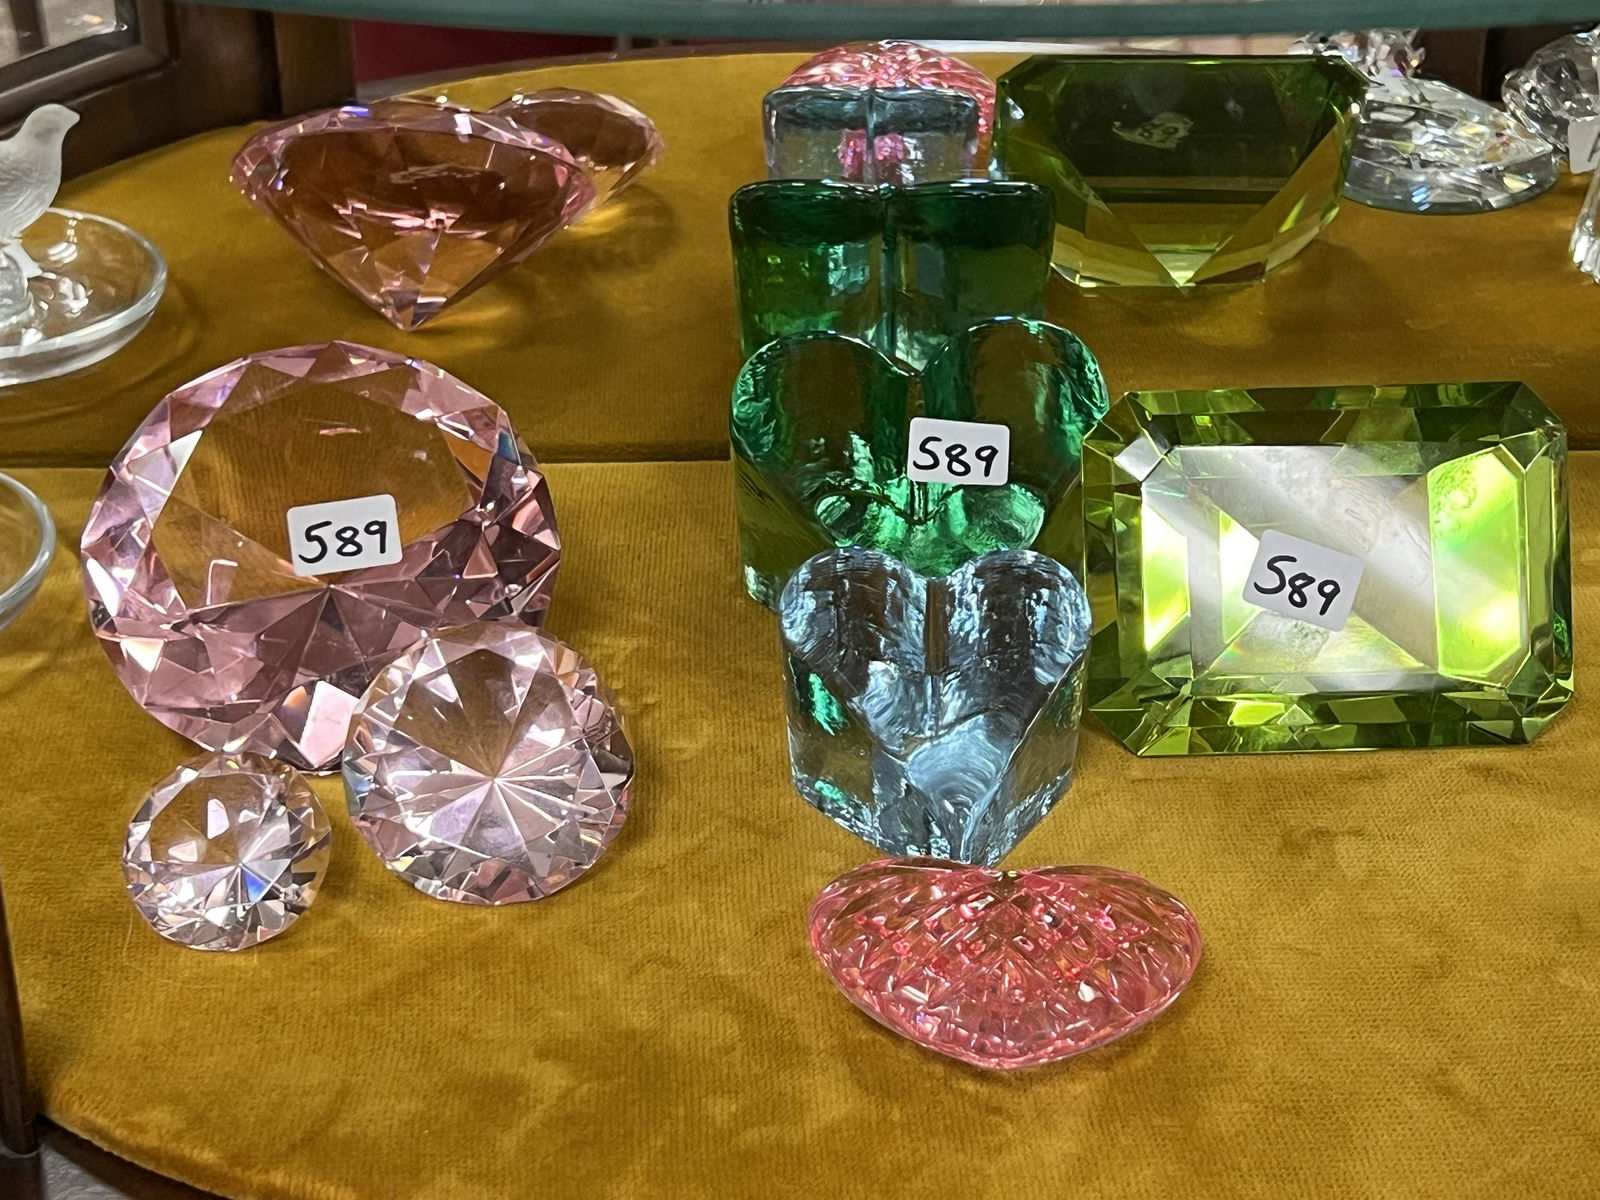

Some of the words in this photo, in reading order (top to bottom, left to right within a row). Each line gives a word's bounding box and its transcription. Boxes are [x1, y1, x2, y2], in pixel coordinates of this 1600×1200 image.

[913, 436, 999, 477] 589
[298, 520, 387, 564] 589
[1253, 555, 1341, 616] 589
